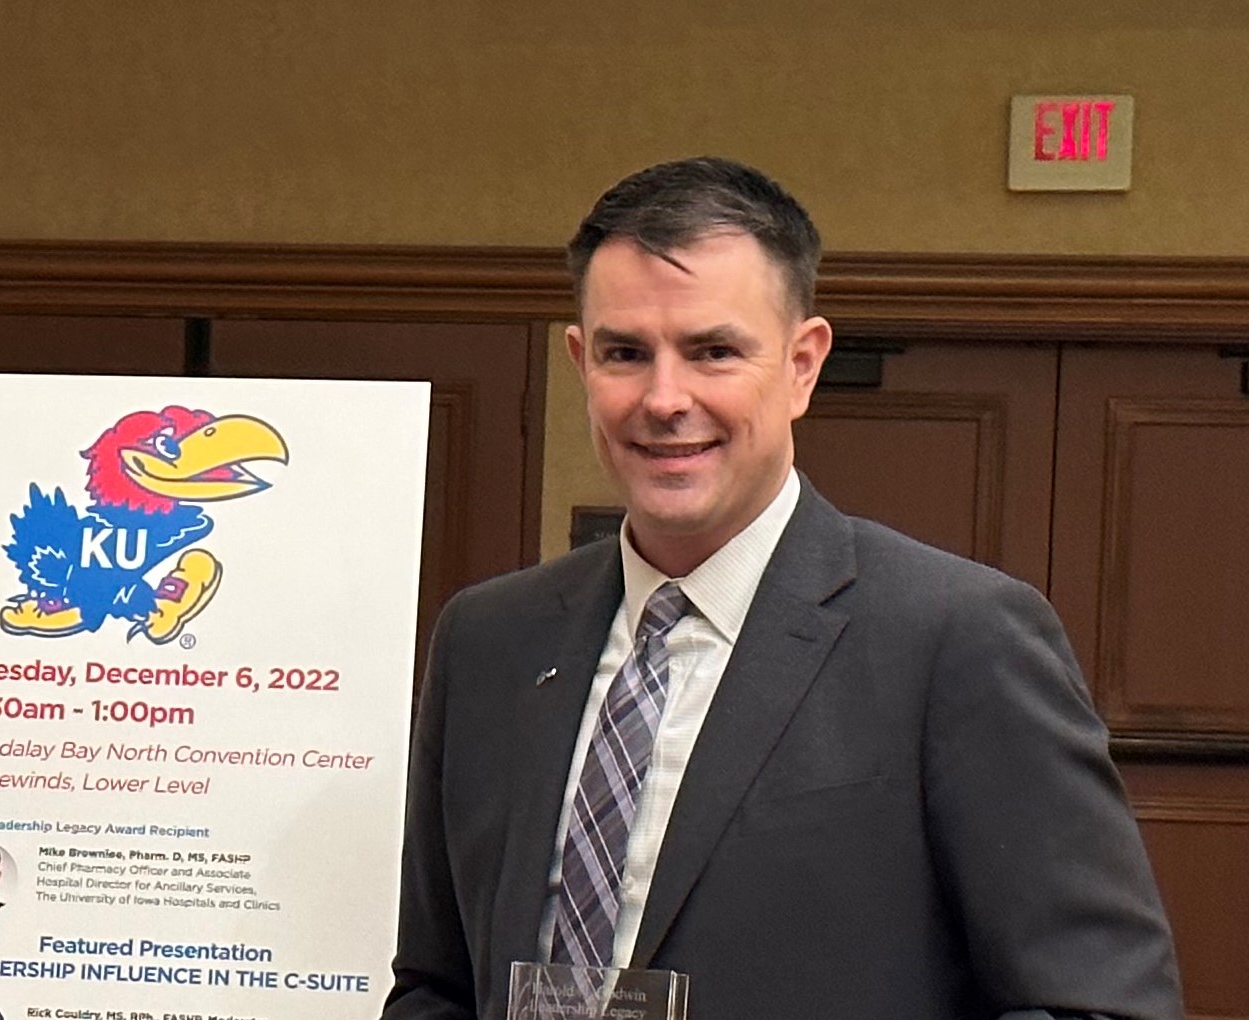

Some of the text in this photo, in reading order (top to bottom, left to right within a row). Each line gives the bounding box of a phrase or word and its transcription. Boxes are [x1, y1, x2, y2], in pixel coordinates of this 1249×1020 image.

[1034, 102, 1115, 161] EXIT
[81, 528, 147, 569] KU
[86, 662, 228, 687] December
[236, 667, 259, 692] 6,
[268, 668, 339, 690] 2022
[92, 700, 194, 727] 1:00pm
[60, 742, 102, 762] Bay
[106, 744, 168, 761] North
[174, 746, 296, 766] Convention
[302, 750, 374, 769] Center
[82, 774, 150, 792] Lower
[153, 777, 211, 794] Level
[55, 822, 102, 835] Legacy
[104, 824, 146, 834] Award
[149, 825, 210, 838] Recipient
[38, 847, 66, 856] Mike
[128, 851, 169, 860] Pharm.
[187, 853, 208, 864] MS,
[37, 862, 252, 879] Chief Pharmacy Officer and Associate
[36, 877, 258, 896] Hospital Director for Ancillary Services,
[35, 891, 281, 910] The University of Iowa Hospitals and Clinics
[39, 936, 271, 962] Featured Presentation
[80, 964, 202, 984] INFLUENCE
[208, 969, 230, 985] IN
[235, 971, 278, 988] THE
[283, 973, 370, 992] C-SUITE
[27, 1008, 52, 1018] Rick
[54, 1009, 103, 1020] Couldry,
